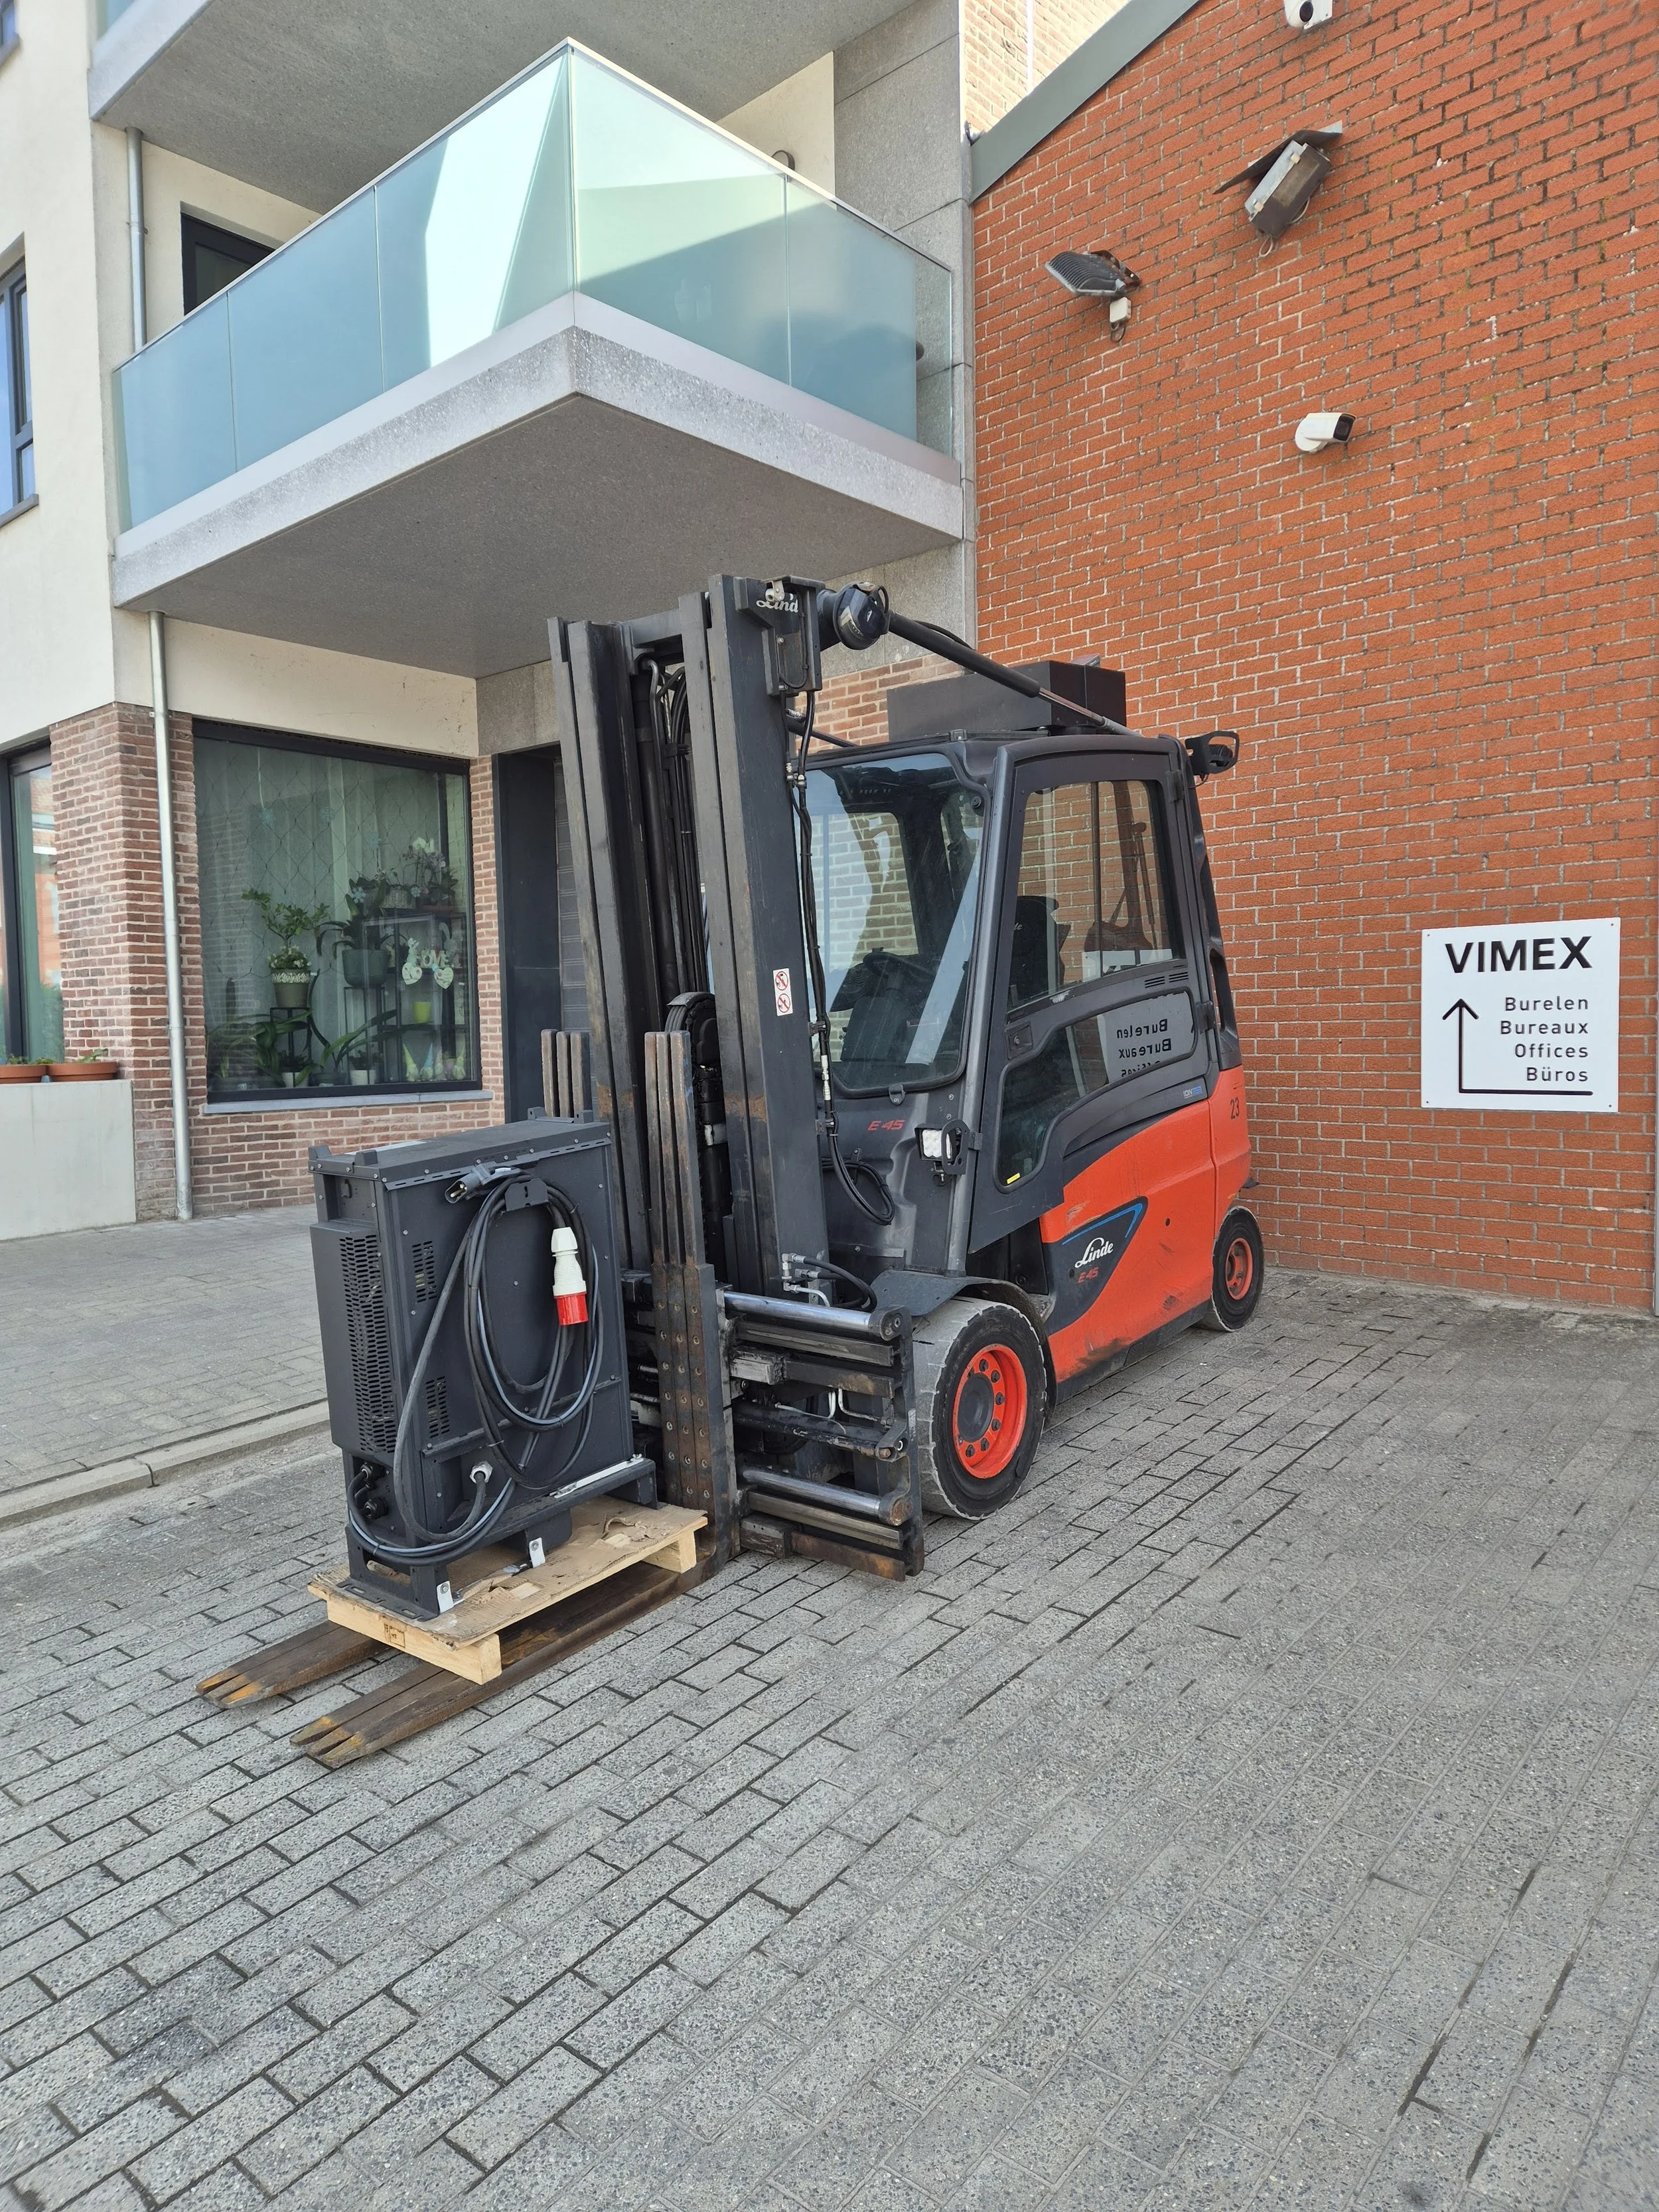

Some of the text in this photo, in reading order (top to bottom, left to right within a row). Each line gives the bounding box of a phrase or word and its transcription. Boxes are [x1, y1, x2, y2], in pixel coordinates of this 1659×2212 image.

[756, 593, 799, 613] Lind
[1445, 936, 1593, 974] VIMEX
[1504, 996, 1589, 1011] Burelen
[1500, 1020, 1589, 1035] Bureaux
[1514, 1043, 1589, 1059] Offices
[1526, 1066, 1589, 1082] Büros
[1230, 1097, 1240, 1120] 23
[1074, 1237, 1114, 1268] Linde
